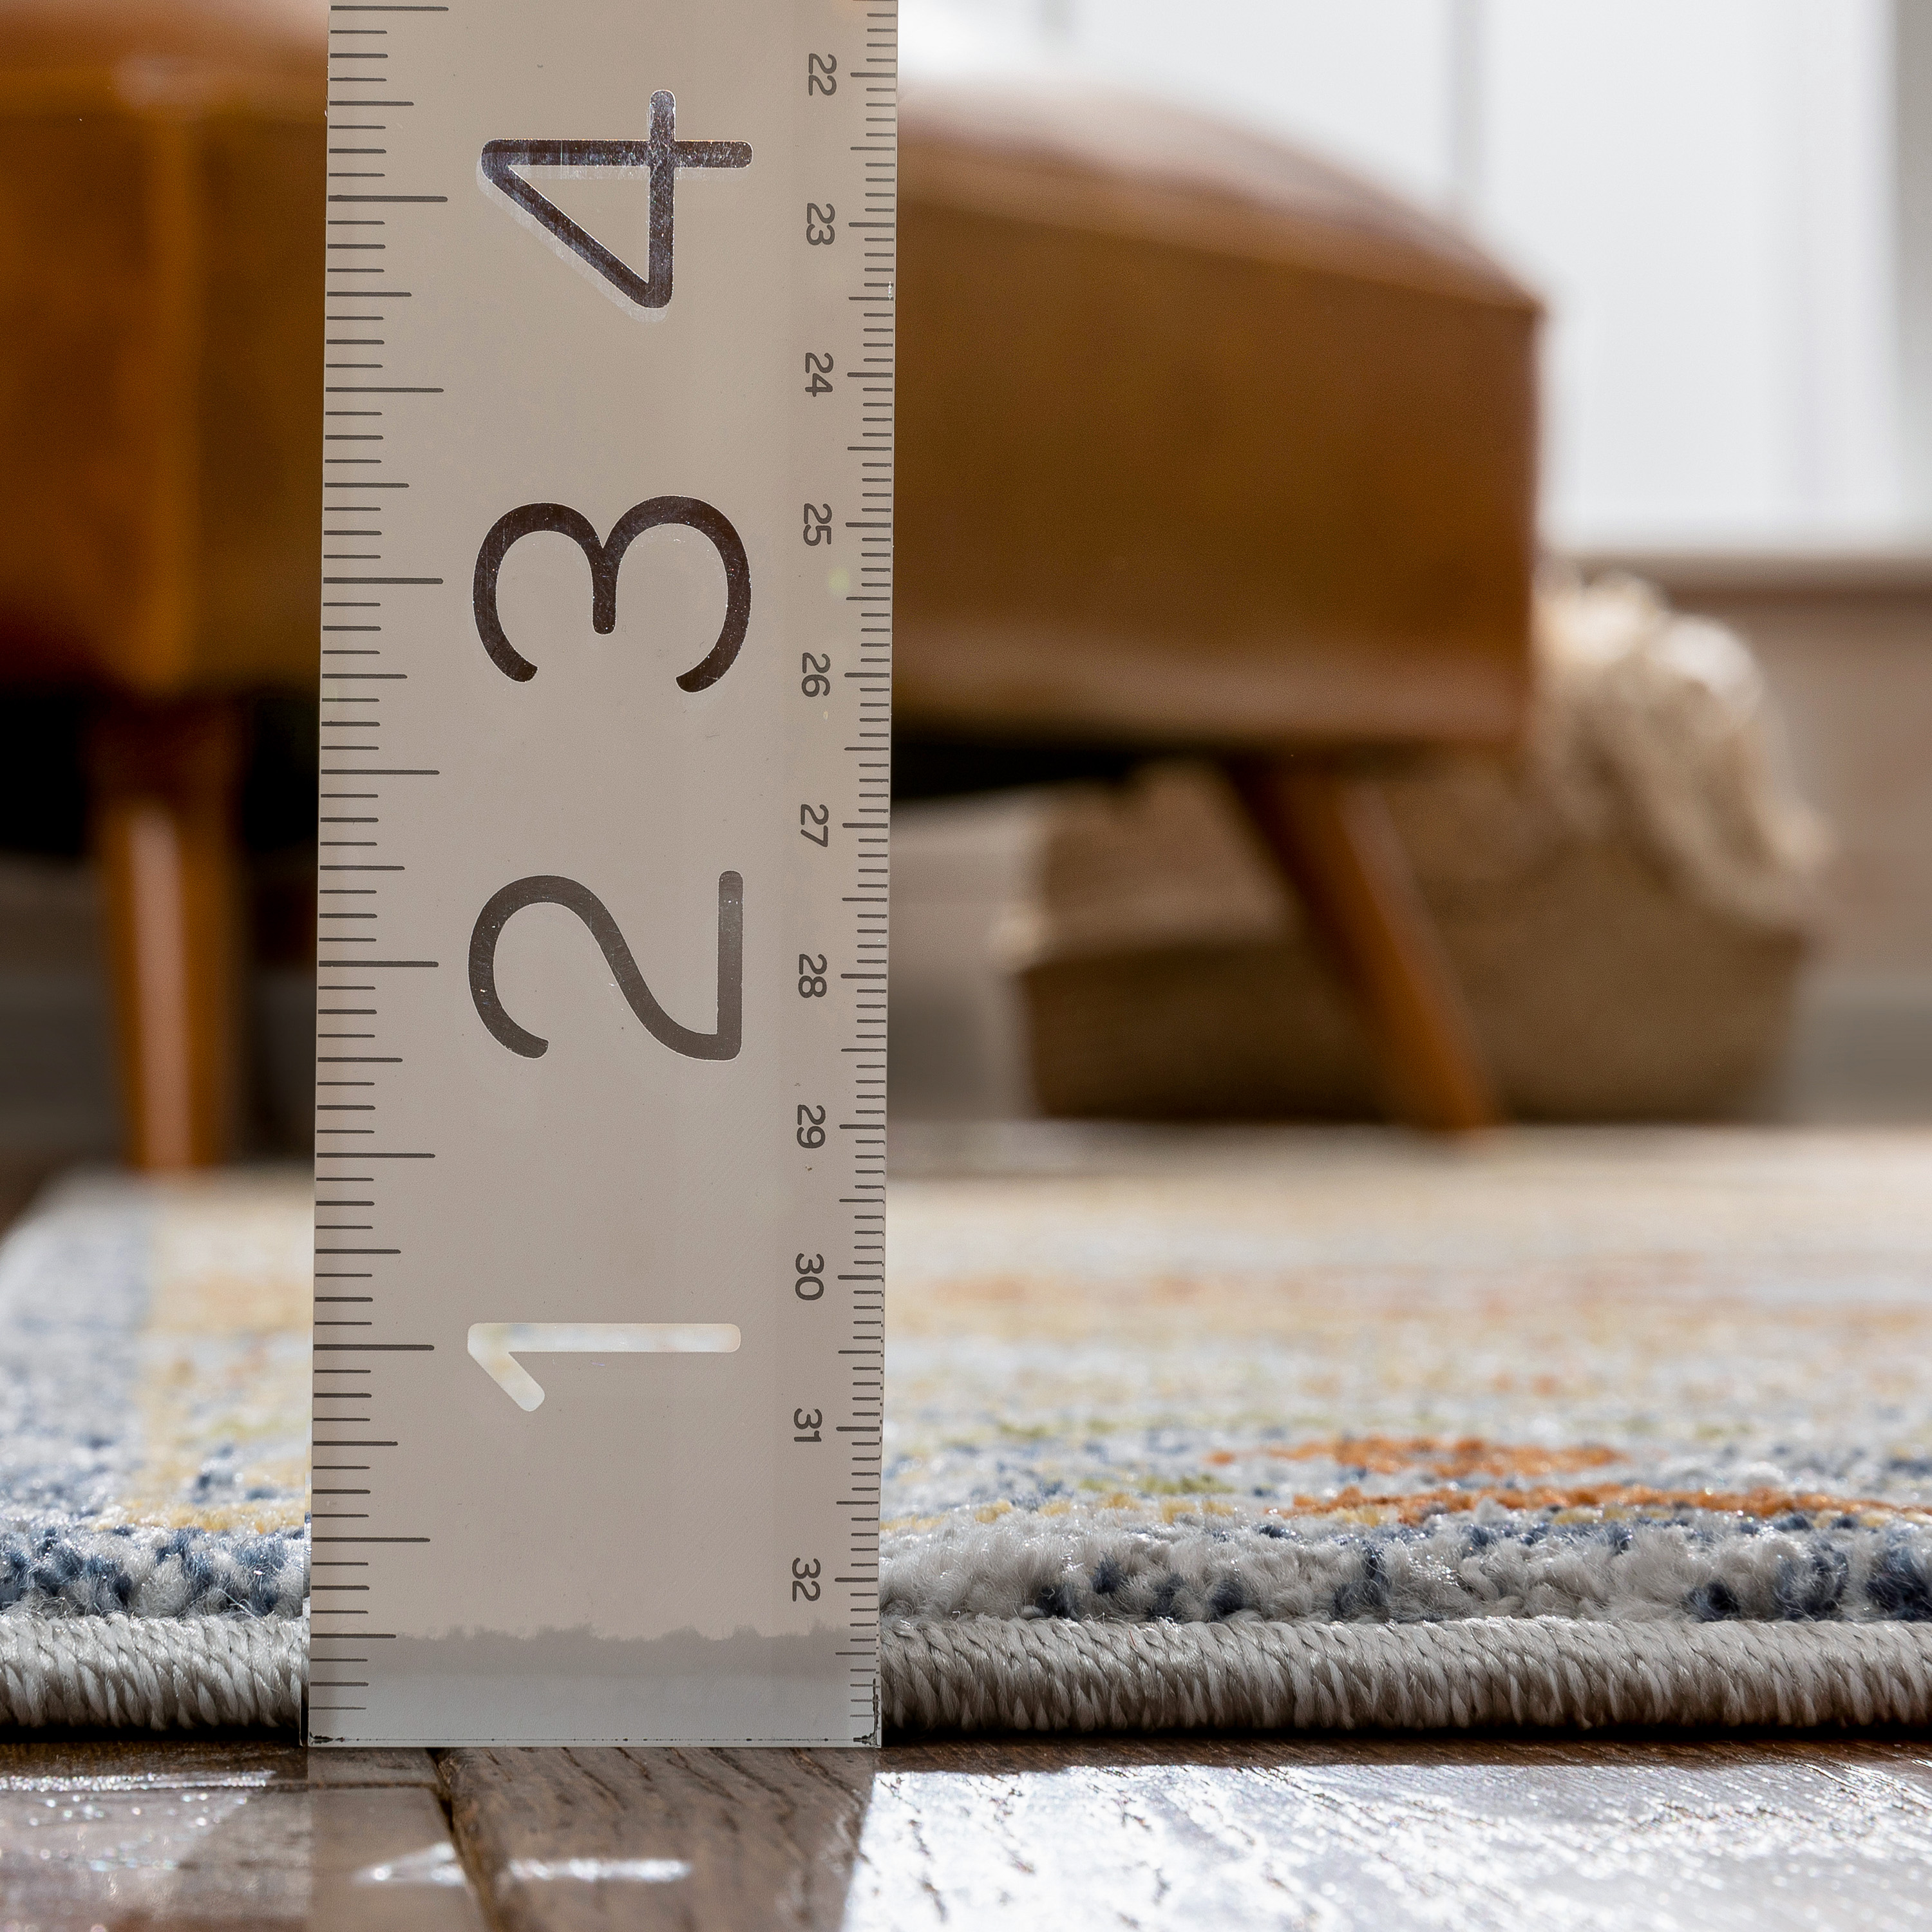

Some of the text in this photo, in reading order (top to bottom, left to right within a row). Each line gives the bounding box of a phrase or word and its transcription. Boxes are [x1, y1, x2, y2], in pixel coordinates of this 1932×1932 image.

[808, 53, 837, 96] 22
[478, 90, 752, 309] 4
[806, 203, 835, 245] 23
[805, 353, 833, 397] 24
[803, 503, 832, 546] 25
[473, 496, 751, 692] 3
[802, 652, 830, 697] 26
[800, 804, 829, 848] 27
[468, 871, 743, 1061] 2
[799, 954, 827, 998] 28
[797, 1104, 826, 1148] 29
[795, 1253, 824, 1300] 30
[468, 1323, 741, 1412] 1
[794, 1408, 822, 1442] 31
[792, 1558, 820, 1602] 32
